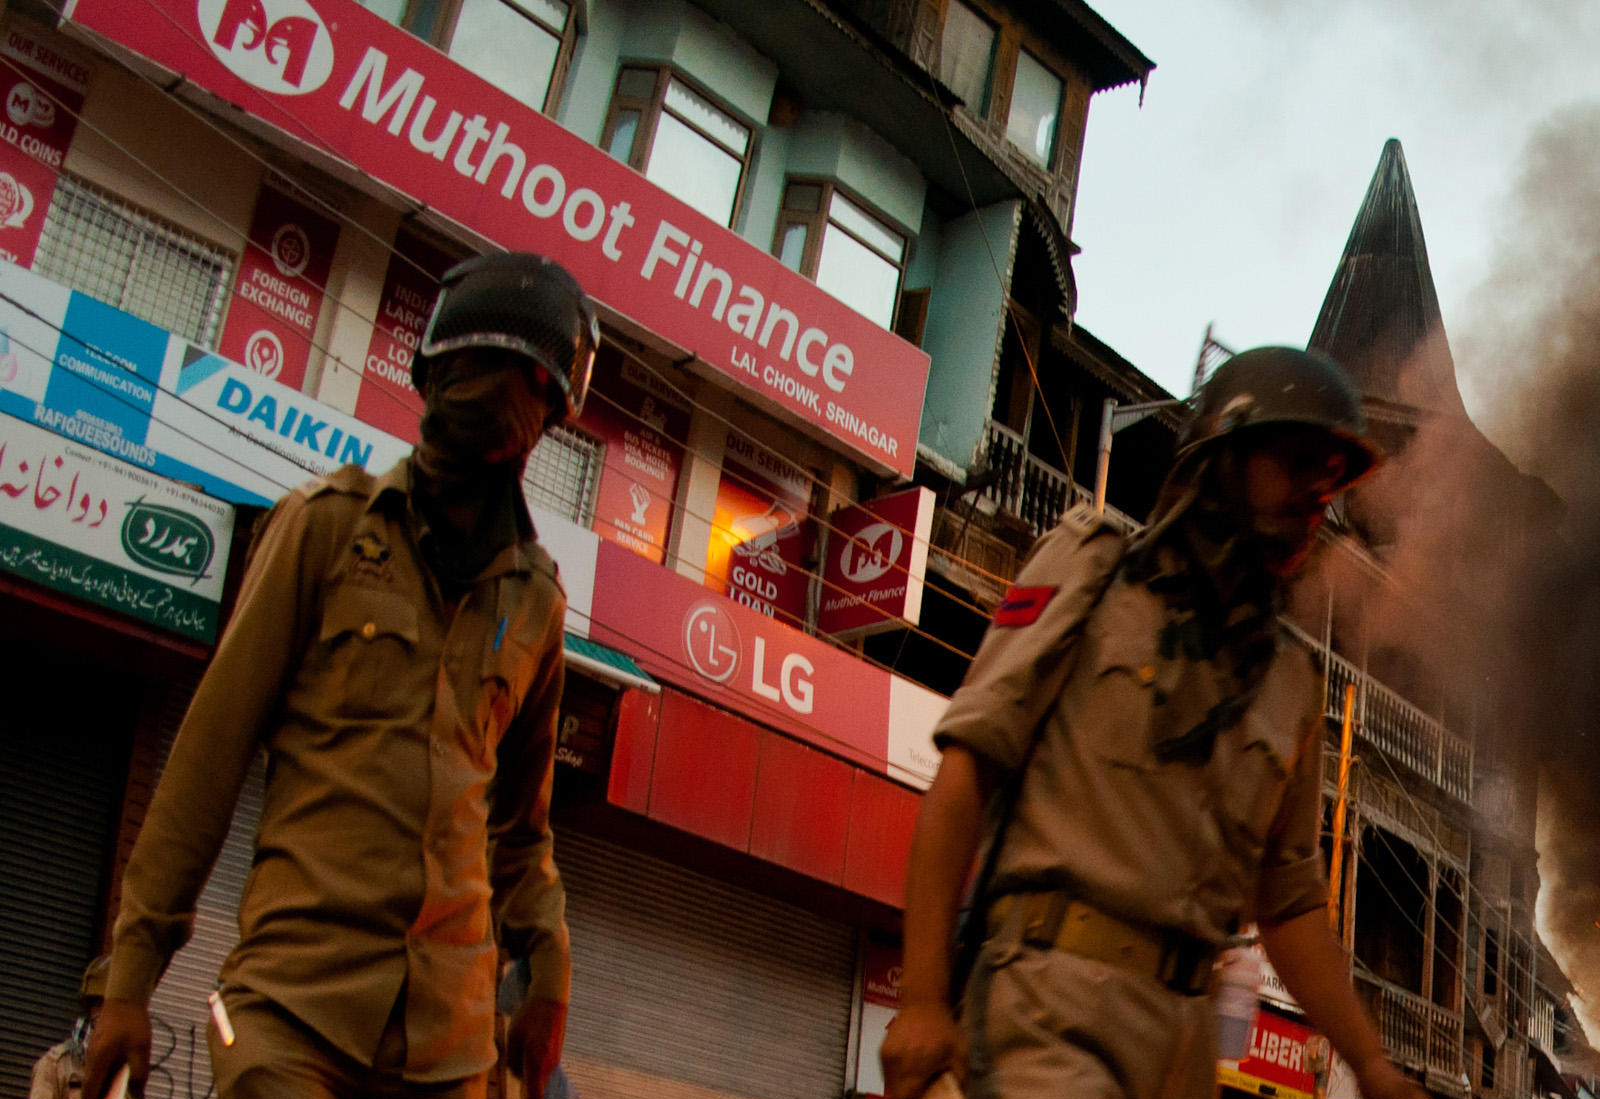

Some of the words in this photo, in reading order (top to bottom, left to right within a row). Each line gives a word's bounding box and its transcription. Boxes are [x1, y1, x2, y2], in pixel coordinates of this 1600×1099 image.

[21, 134, 63, 167] COINS
[339, 46, 635, 262] Muthoot
[640, 219, 855, 393] Finance
[240, 281, 314, 329] EXCHANGE
[252, 268, 310, 309] FOREIGN
[58, 353, 152, 403] COMMUNICATION
[731, 346, 759, 378] LAL
[763, 365, 822, 418] CHOWK,
[825, 401, 898, 458] SRINAGAR
[217, 377, 373, 470] DAIKIN
[646, 453, 670, 473] HOTEL
[726, 432, 754, 461] OUR
[625, 453, 666, 481] BOOKINGS
[614, 517, 631, 533] PAN
[616, 530, 650, 553] SERVICE
[732, 566, 778, 600] GOLD
[825, 592, 866, 612] Muthoot
[867, 584, 906, 604] Finance
[752, 635, 815, 715] LG
[1248, 1026, 1306, 1074] LIBER
